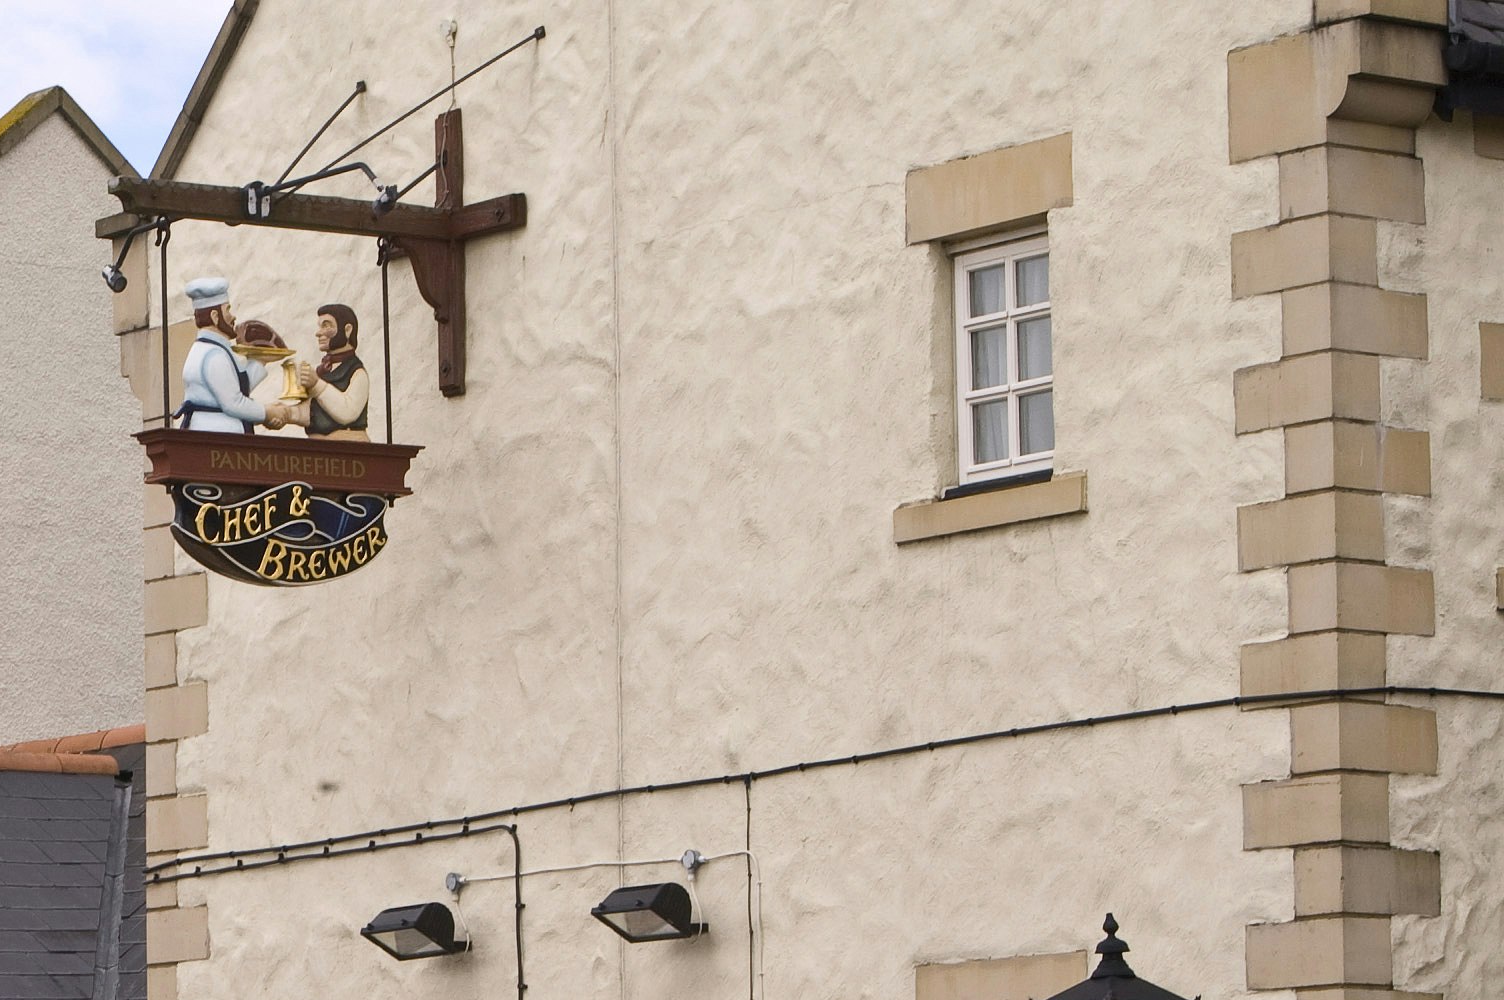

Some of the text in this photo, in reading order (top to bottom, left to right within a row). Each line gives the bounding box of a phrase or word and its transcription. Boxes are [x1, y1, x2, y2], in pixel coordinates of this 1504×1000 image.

[210, 450, 366, 479] PANMUREFIELD
[289, 485, 311, 517] &
[257, 527, 388, 581] BREWER
